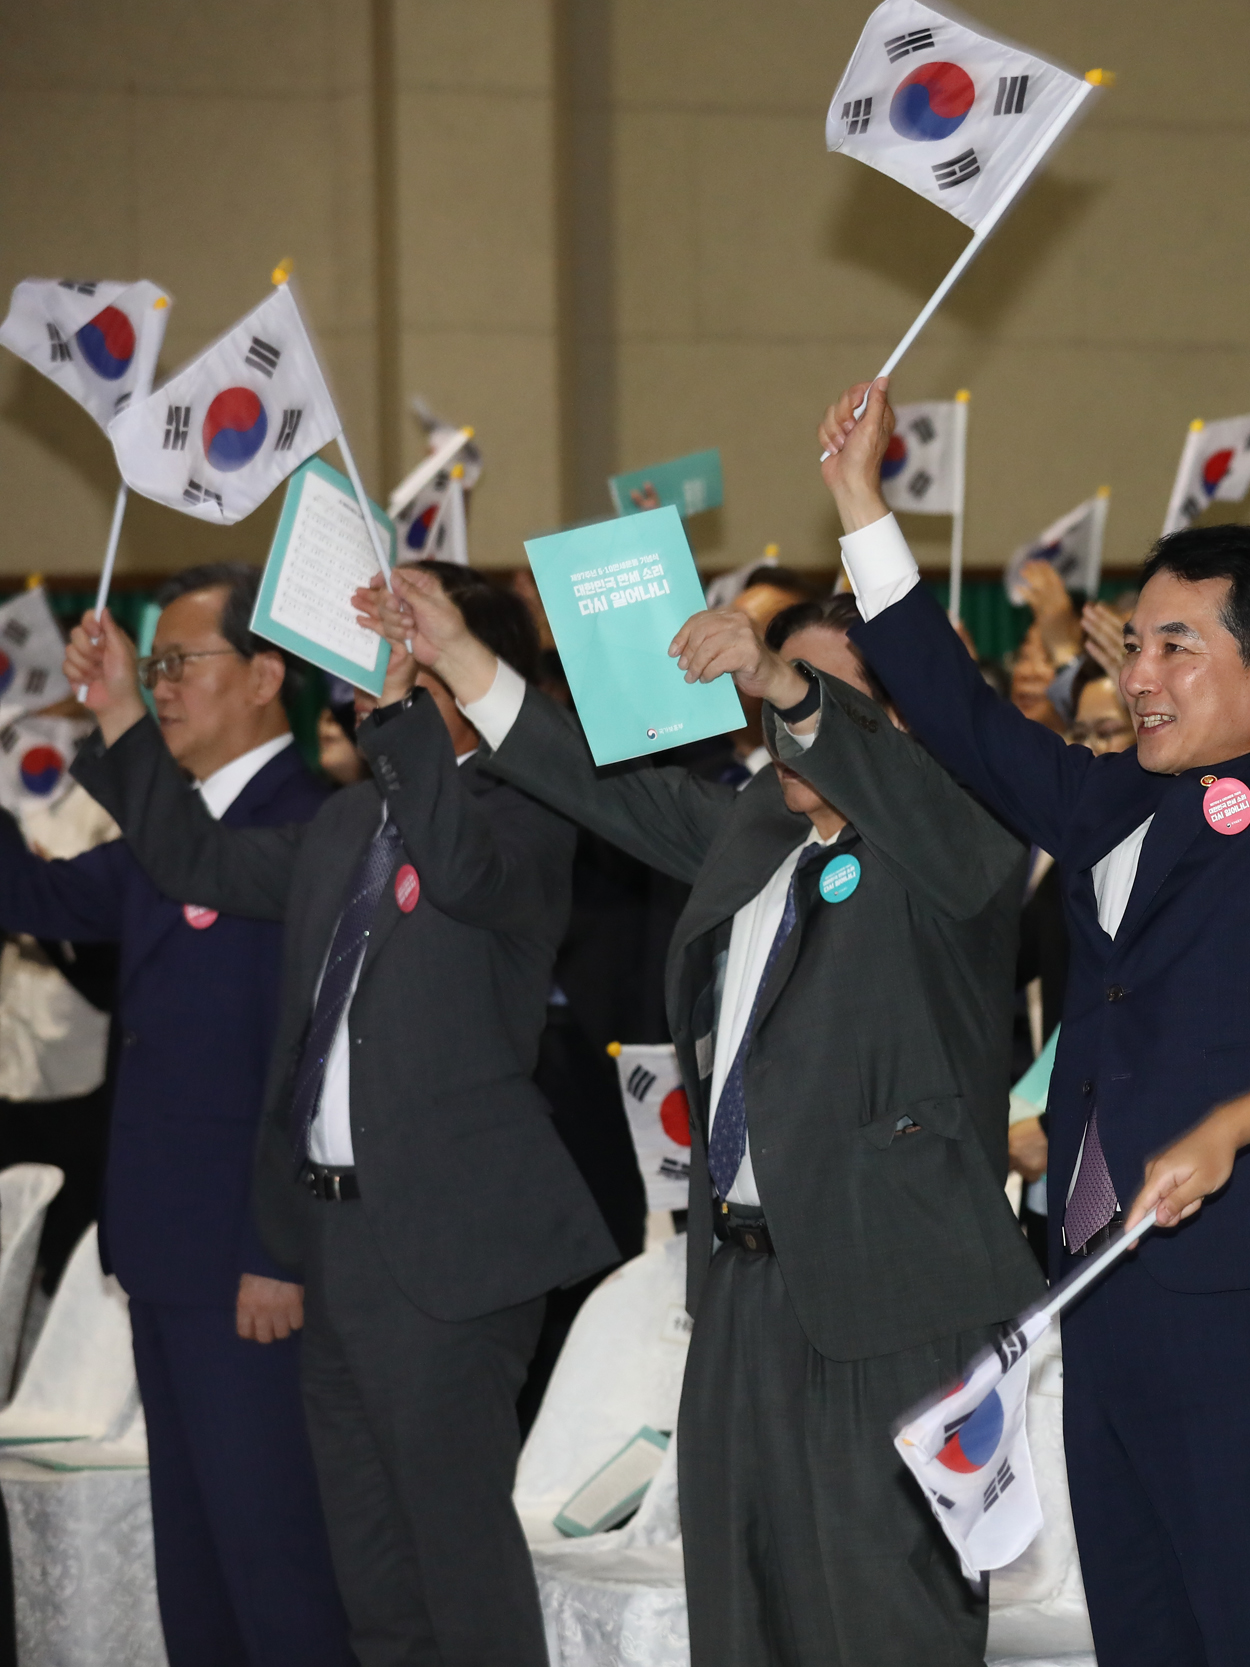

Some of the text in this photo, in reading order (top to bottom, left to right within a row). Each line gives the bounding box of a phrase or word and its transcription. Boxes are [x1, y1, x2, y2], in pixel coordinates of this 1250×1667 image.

[570, 568, 598, 582] 제97주년
[639, 553, 660, 564] 기념식
[573, 564, 664, 597] 대한민국 만세 소리
[578, 579, 671, 616] 다시 일어나니
[1208, 802, 1227, 815] 대한민국
[1226, 798, 1237, 807] 만세
[1237, 793, 1247, 803] 소리
[1210, 811, 1225, 823] 다시
[1224, 800, 1250, 817] 일어나니
